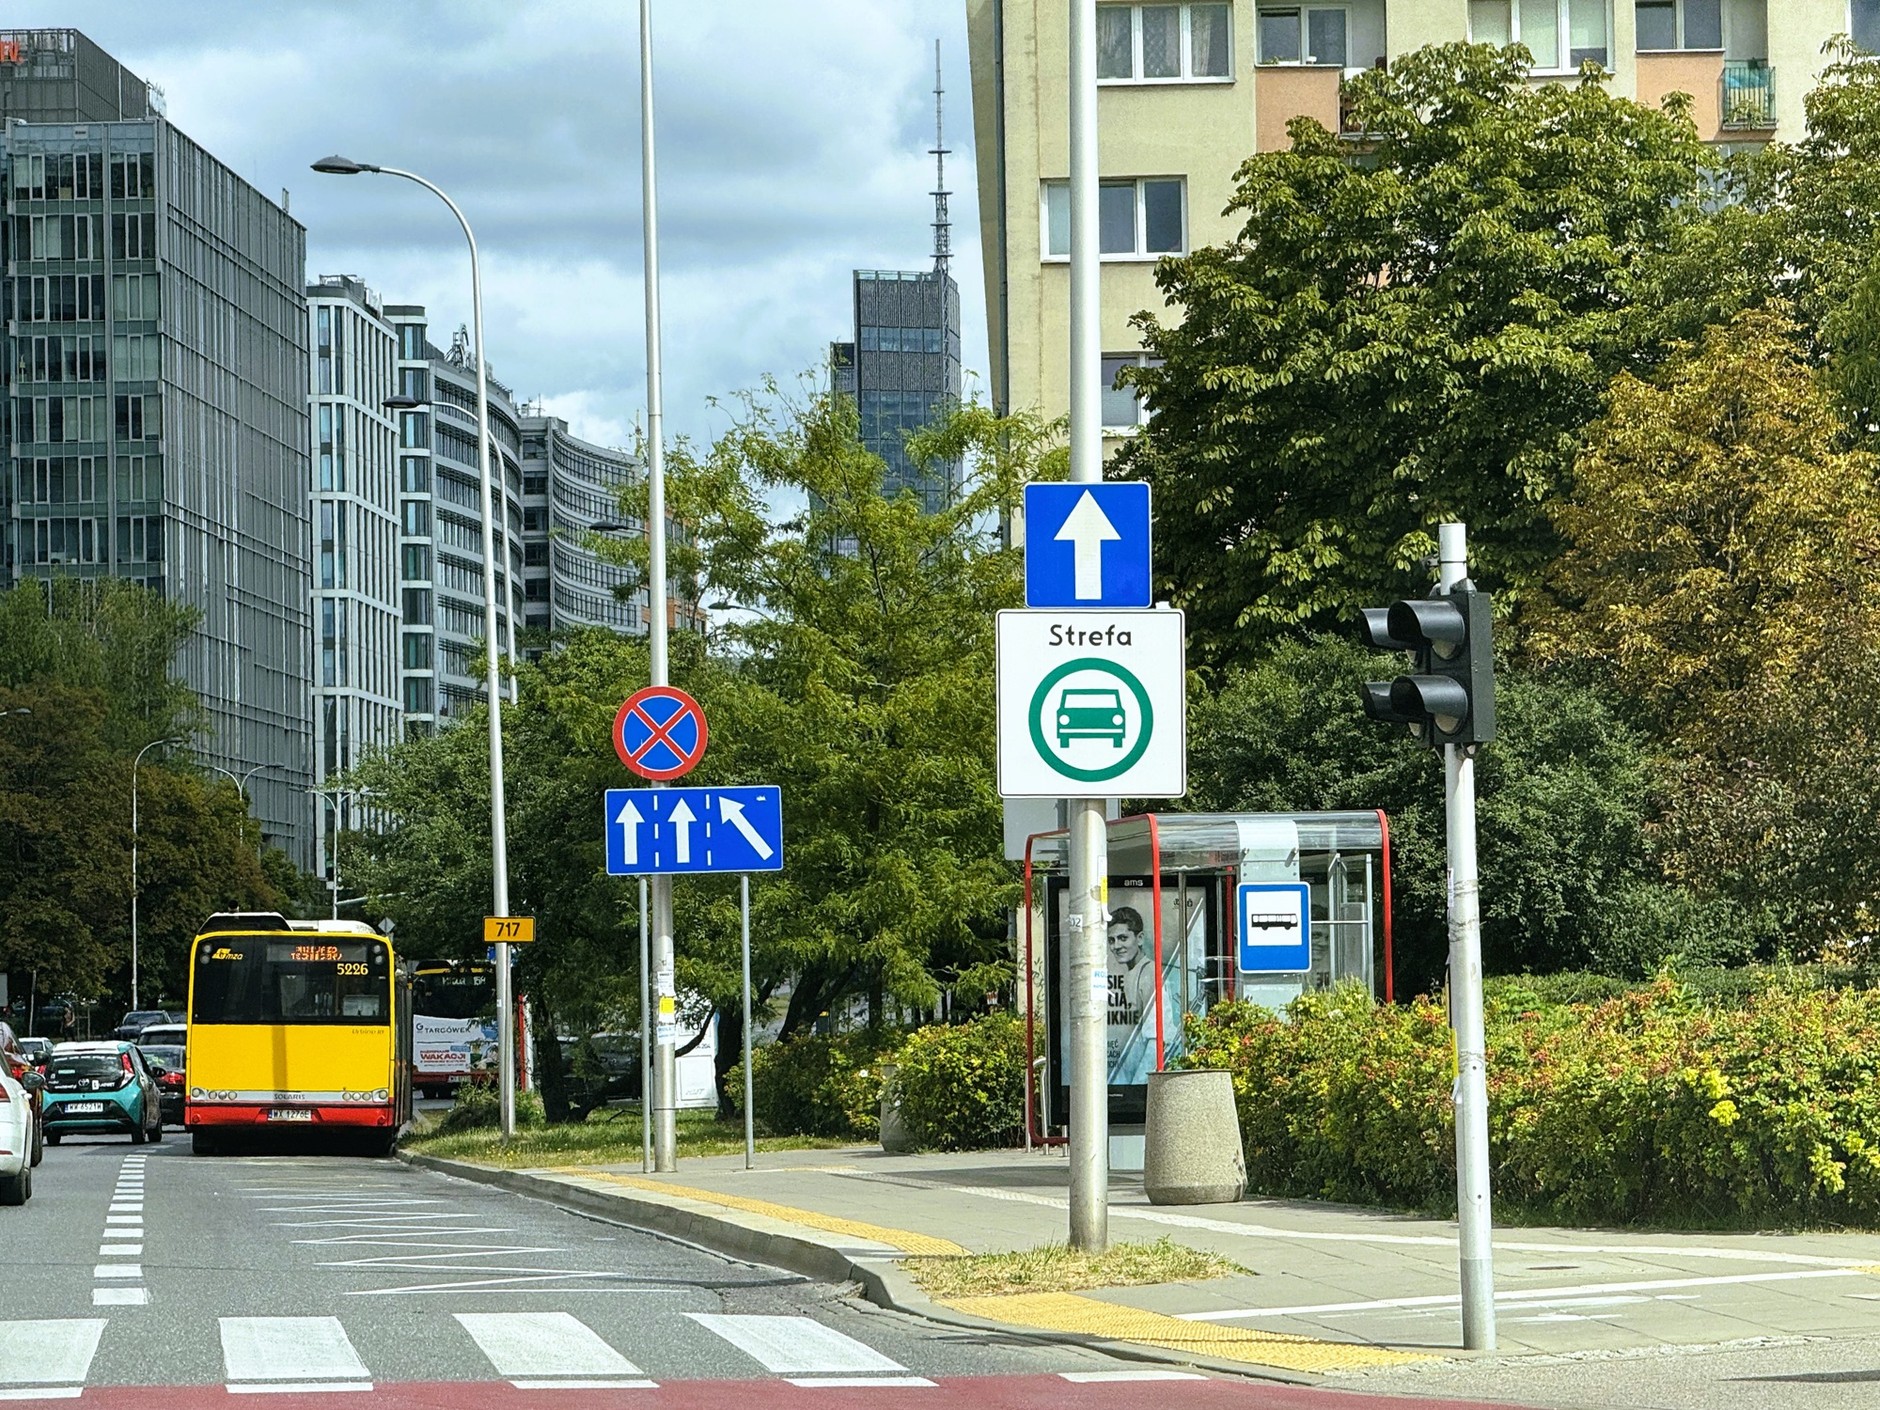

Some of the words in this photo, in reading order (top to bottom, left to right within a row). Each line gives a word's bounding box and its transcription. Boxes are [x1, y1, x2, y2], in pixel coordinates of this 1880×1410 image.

[1049, 624, 1132, 646] Strefa
[1124, 879, 1144, 887] ams
[496, 922, 520, 937] 717
[337, 963, 369, 976] 5226
[425, 1026, 471, 1034] TARGÓWEK
